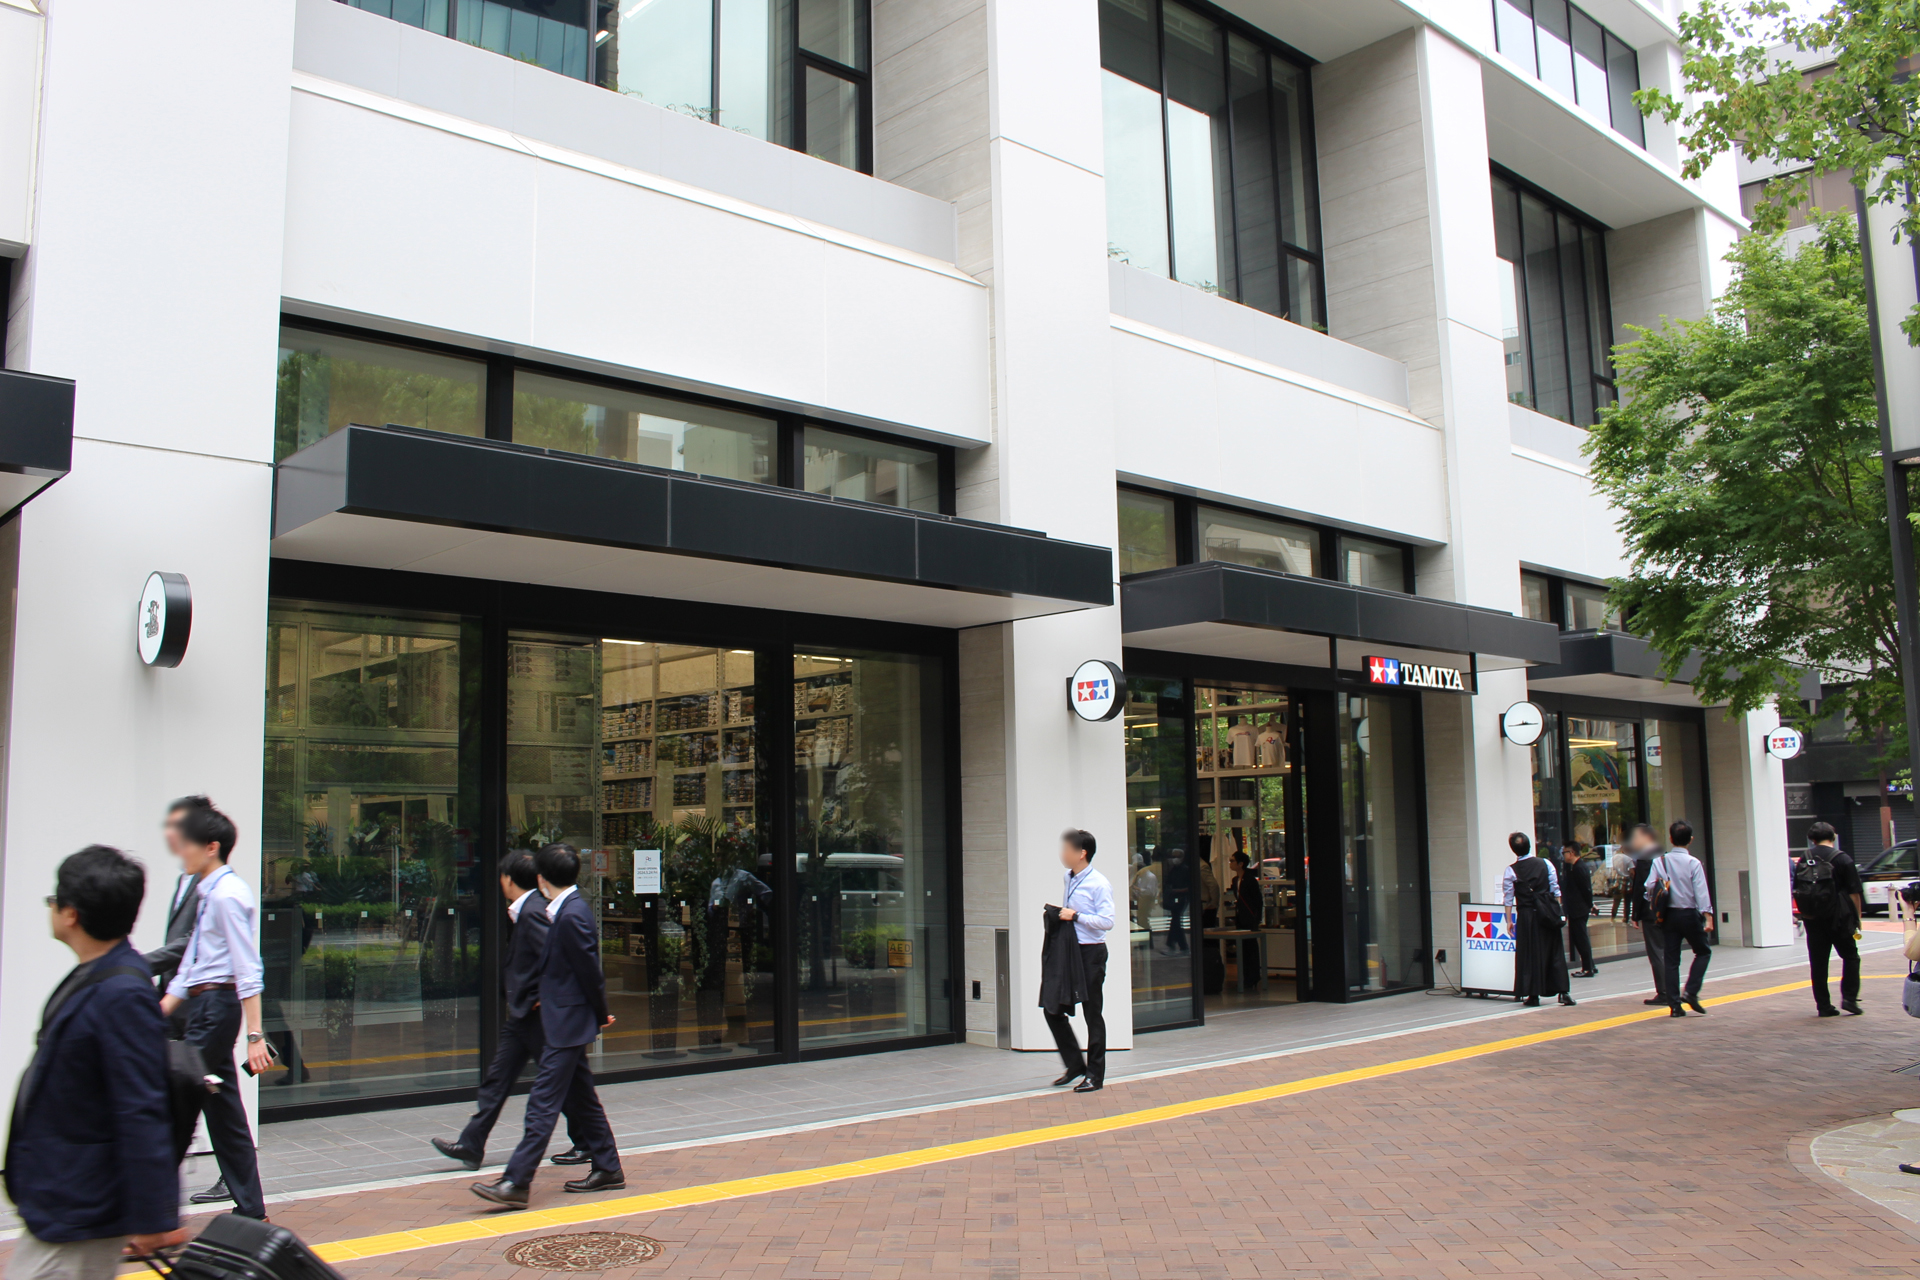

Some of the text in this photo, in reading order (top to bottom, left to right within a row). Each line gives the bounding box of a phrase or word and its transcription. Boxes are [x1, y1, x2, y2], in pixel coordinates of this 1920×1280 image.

[1400, 662, 1464, 690] TAMIYA
[889, 943, 910, 953] AED
[1466, 939, 1516, 952] TAMIYA
